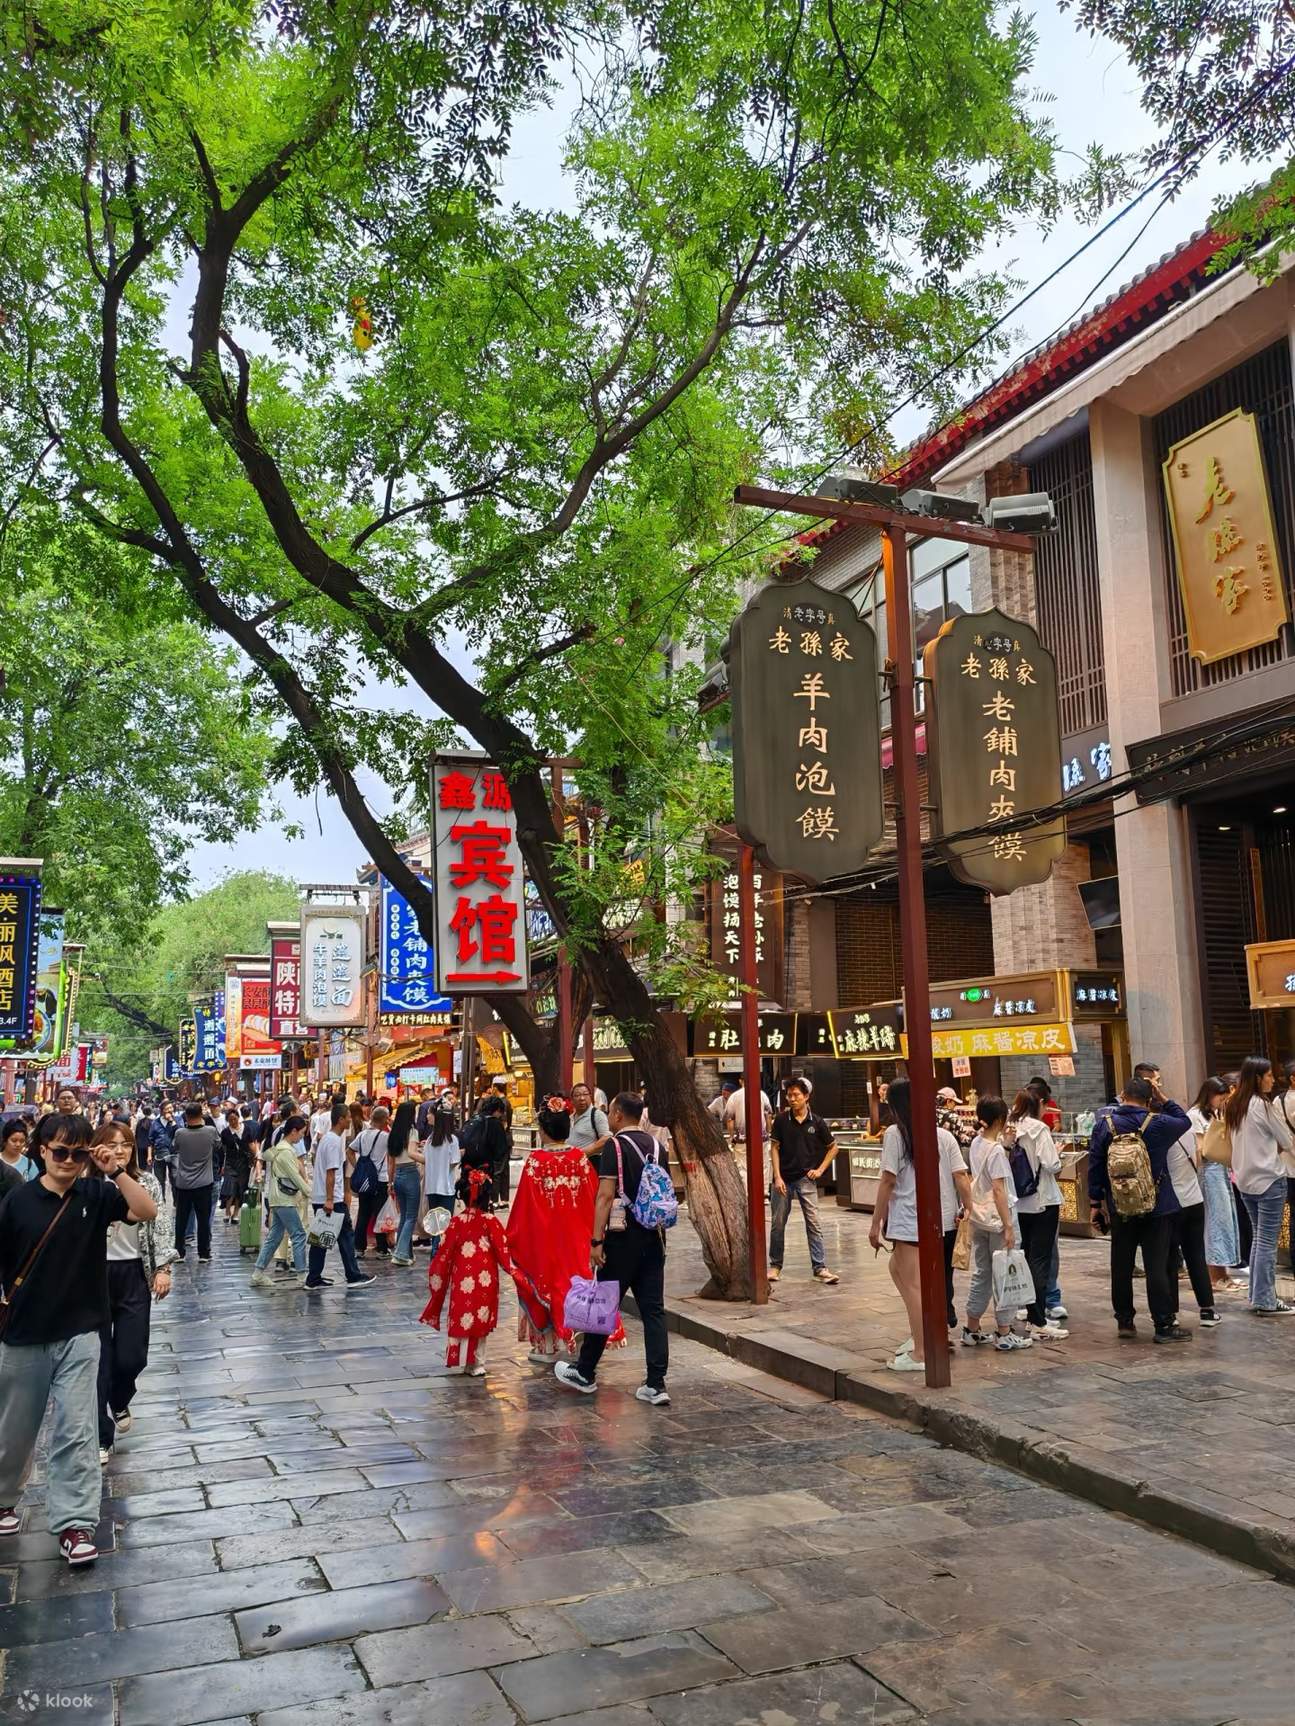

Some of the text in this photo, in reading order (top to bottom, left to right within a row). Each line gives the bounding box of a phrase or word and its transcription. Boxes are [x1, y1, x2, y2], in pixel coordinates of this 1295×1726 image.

[768, 625, 853, 661] 老孫家
[961, 652, 1037, 685] 老孫家
[449, 820, 518, 965] 宾馆
